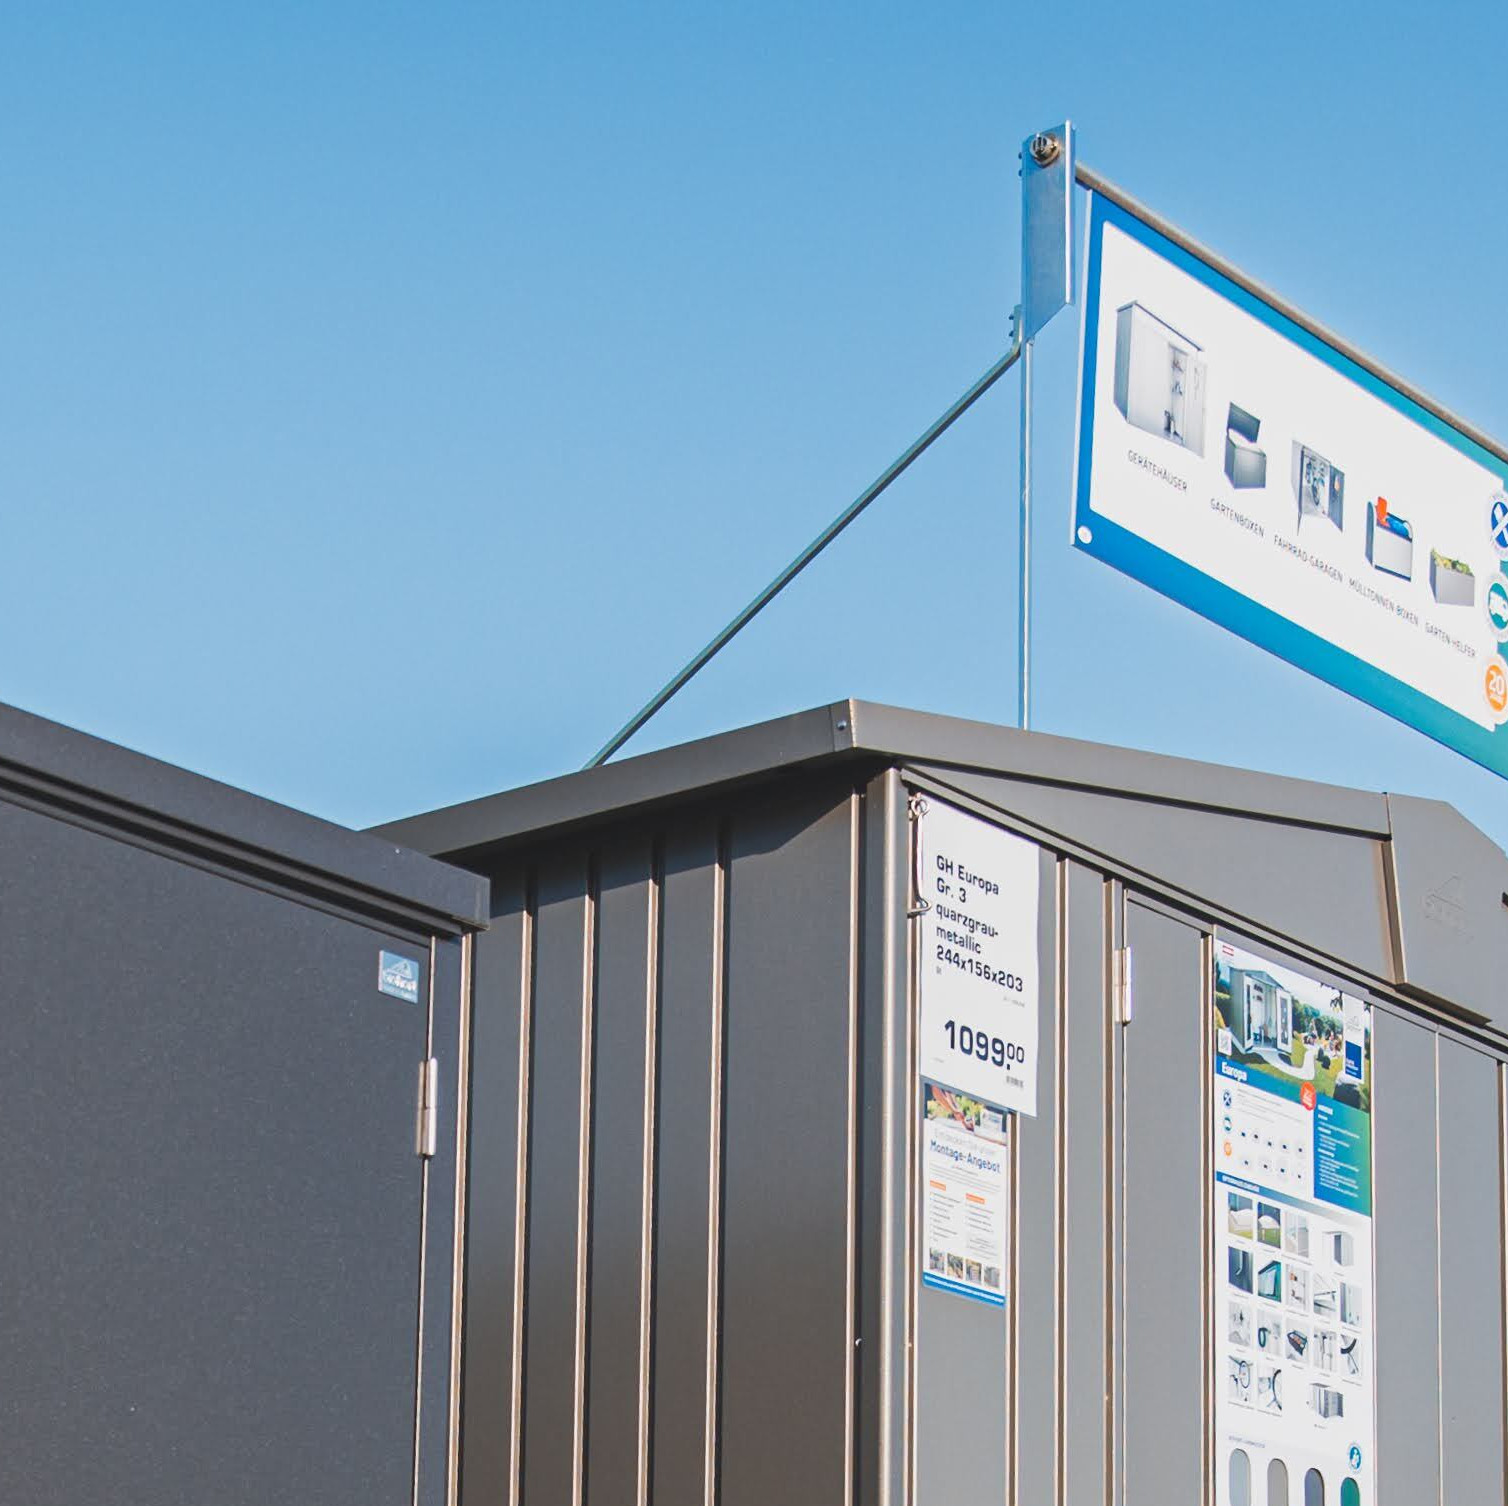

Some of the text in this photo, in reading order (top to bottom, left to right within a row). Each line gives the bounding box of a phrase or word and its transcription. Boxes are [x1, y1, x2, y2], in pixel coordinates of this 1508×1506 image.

[1488, 669, 1506, 695] 20
[936, 854, 999, 896] GH Europa
[936, 877, 967, 903] Gr. 3
[936, 903, 999, 938] quarzgrau-
[936, 926, 982, 954] metallic
[936, 944, 1024, 993] 244x156x203
[1221, 1061, 1248, 1082] Europa
[930, 1138, 1002, 1175] Montage-Angebot
